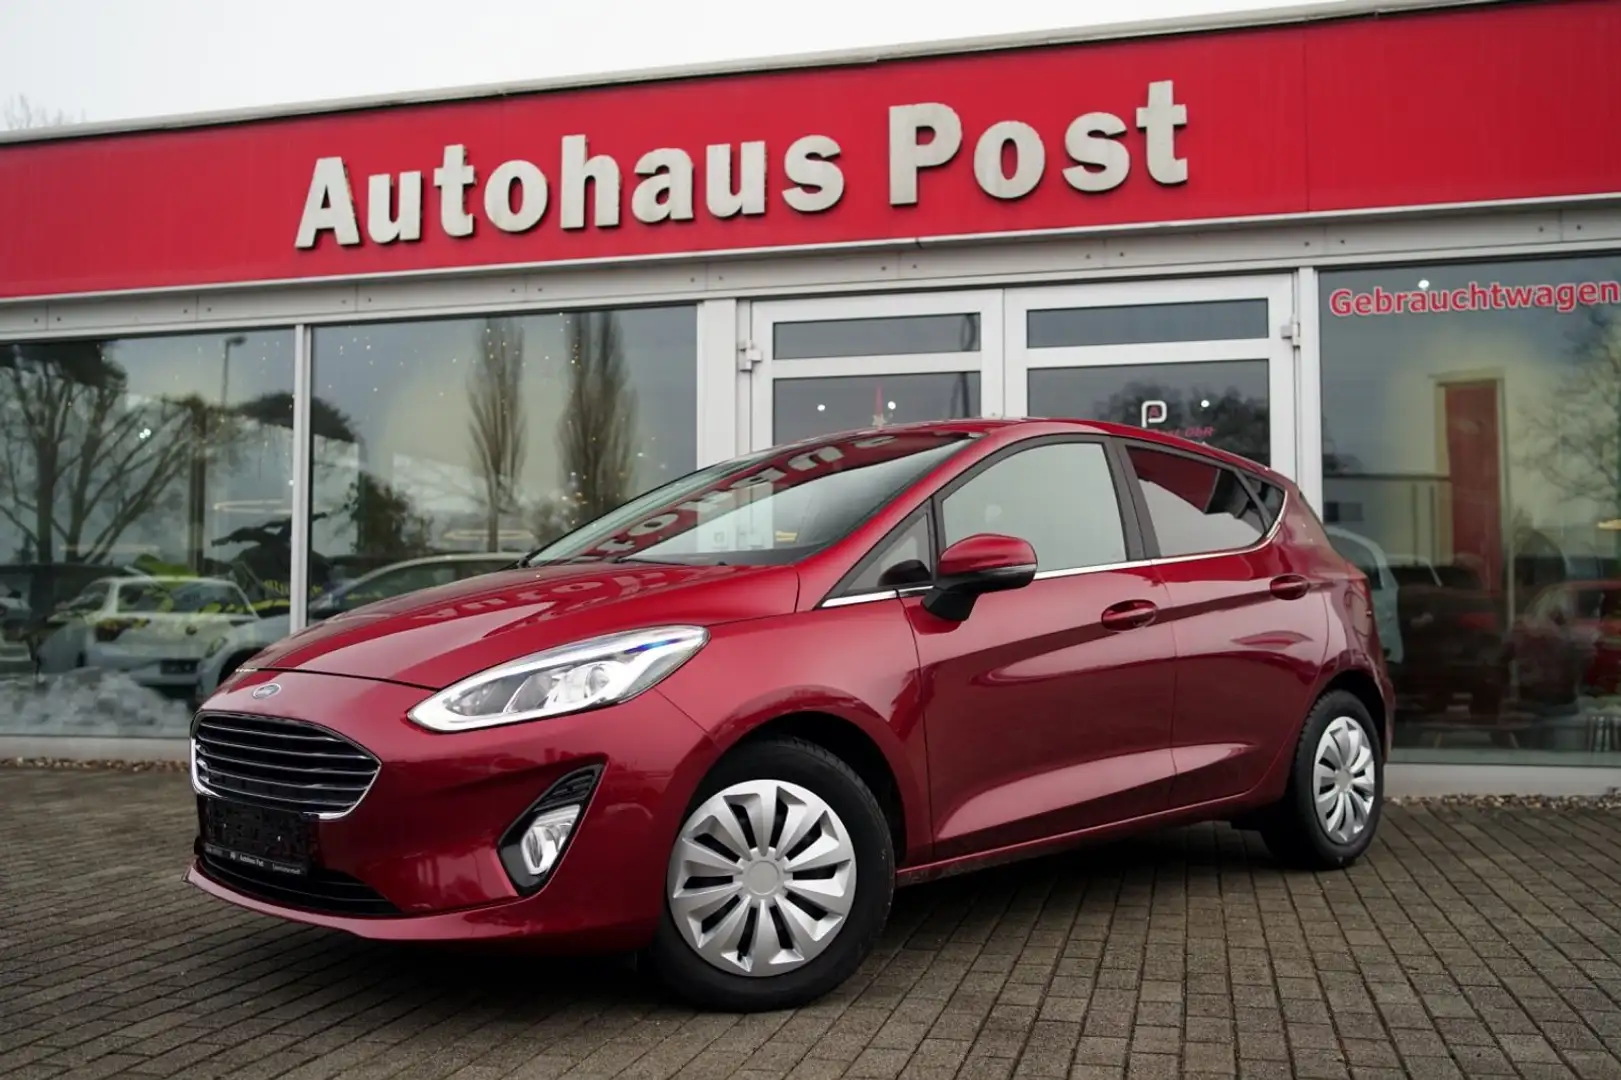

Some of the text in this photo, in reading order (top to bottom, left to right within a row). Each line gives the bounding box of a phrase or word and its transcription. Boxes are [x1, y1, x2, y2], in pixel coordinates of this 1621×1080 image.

[296, 80, 1189, 250] Autohaus Post
[1329, 280, 1621, 317] Gebrauchtwagen
